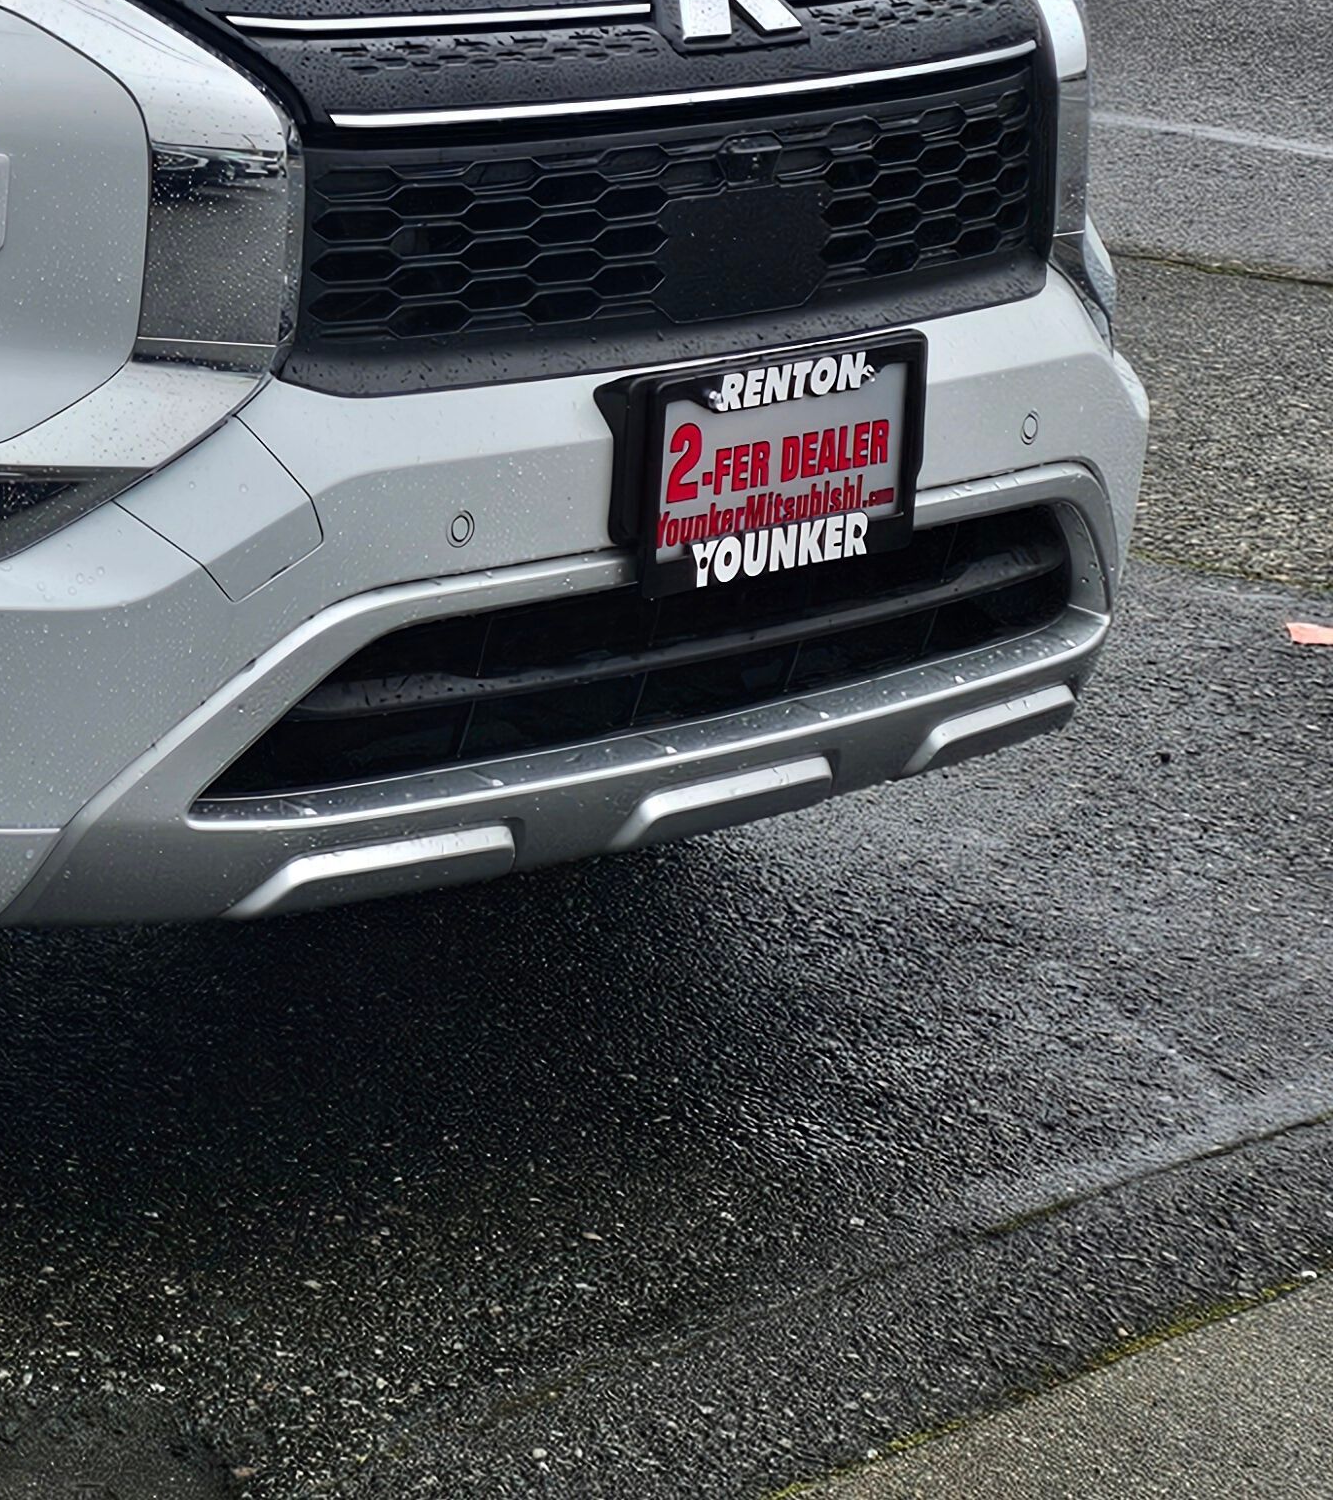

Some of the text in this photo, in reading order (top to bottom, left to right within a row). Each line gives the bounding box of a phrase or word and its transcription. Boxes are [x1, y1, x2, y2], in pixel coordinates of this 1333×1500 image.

[718, 352, 867, 412] RENTON
[665, 418, 890, 504] 2-FER DEALER
[691, 511, 868, 588] YOUNKER
